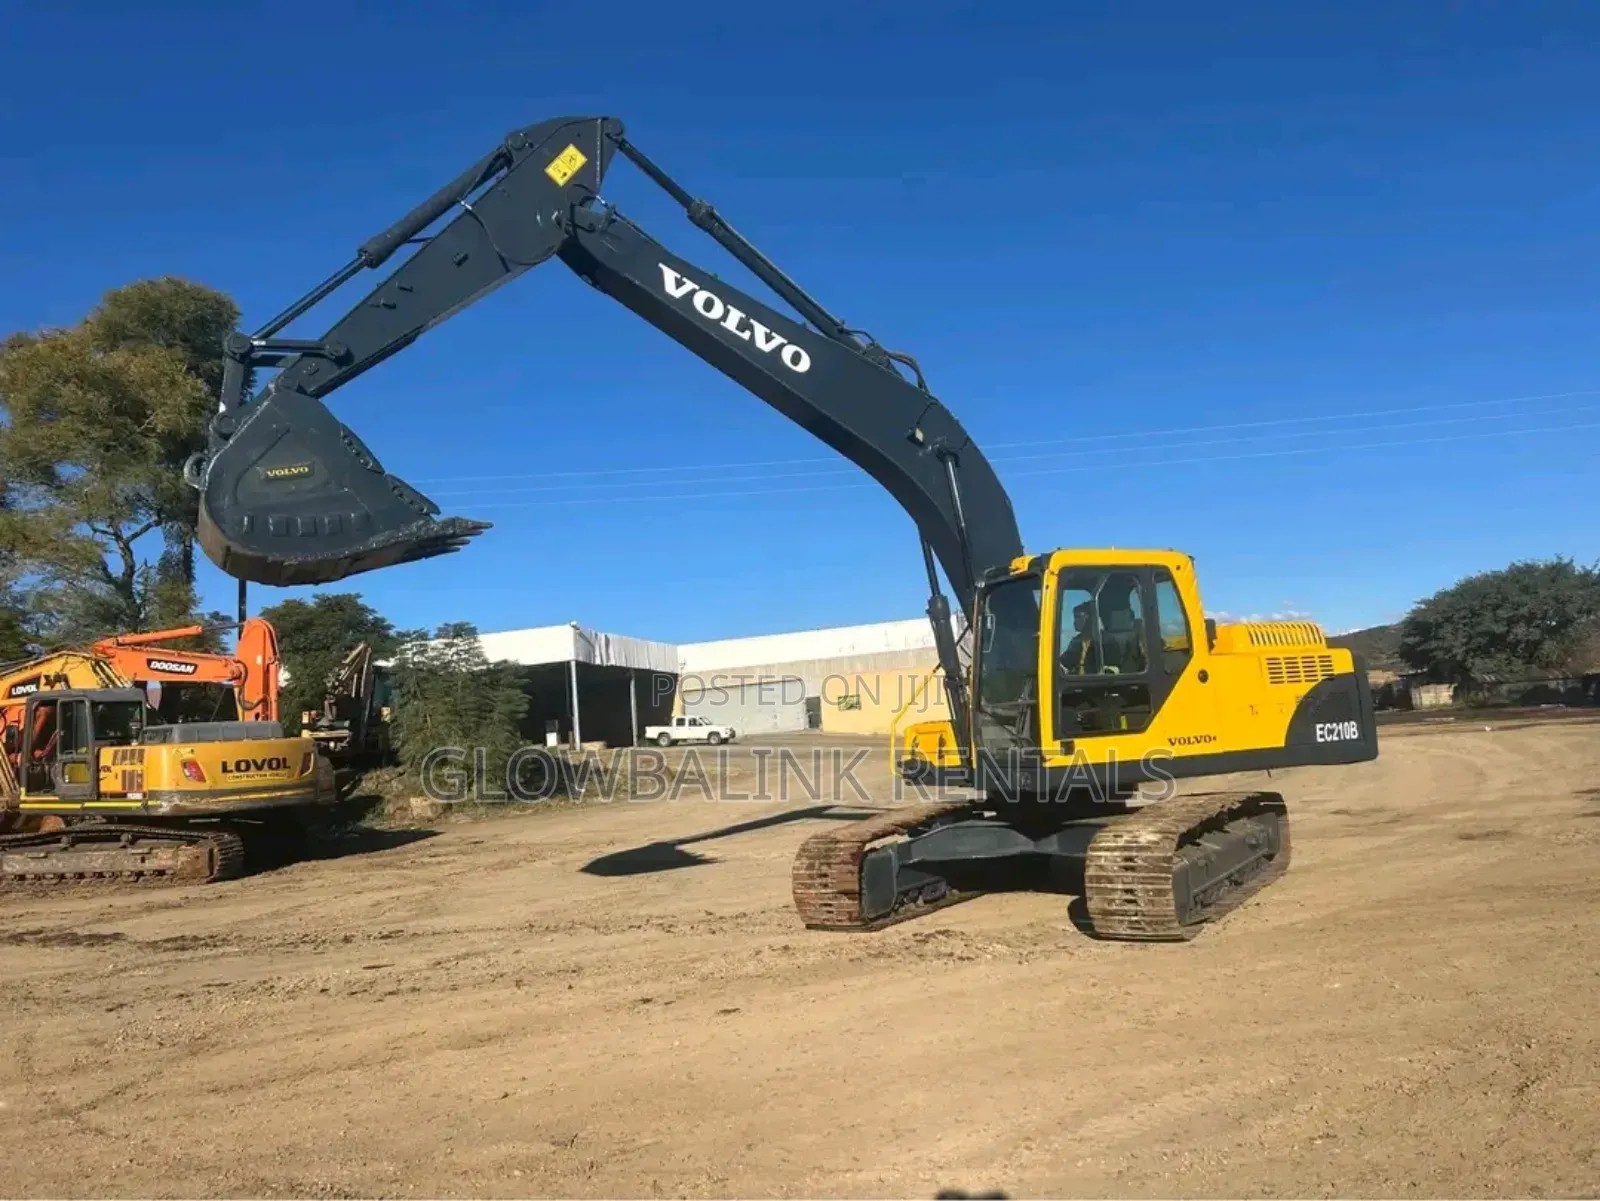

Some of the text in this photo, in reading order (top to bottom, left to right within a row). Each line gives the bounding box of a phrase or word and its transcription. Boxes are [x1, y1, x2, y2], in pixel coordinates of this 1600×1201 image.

[658, 262, 811, 373] VOLVO
[266, 466, 309, 477] VOLVO
[150, 661, 195, 673] DOOSAN
[11, 684, 38, 696] LOVOL
[1316, 721, 1359, 742] EC210B
[1167, 734, 1212, 746] VOLVO
[221, 757, 291, 773] LOVOL
